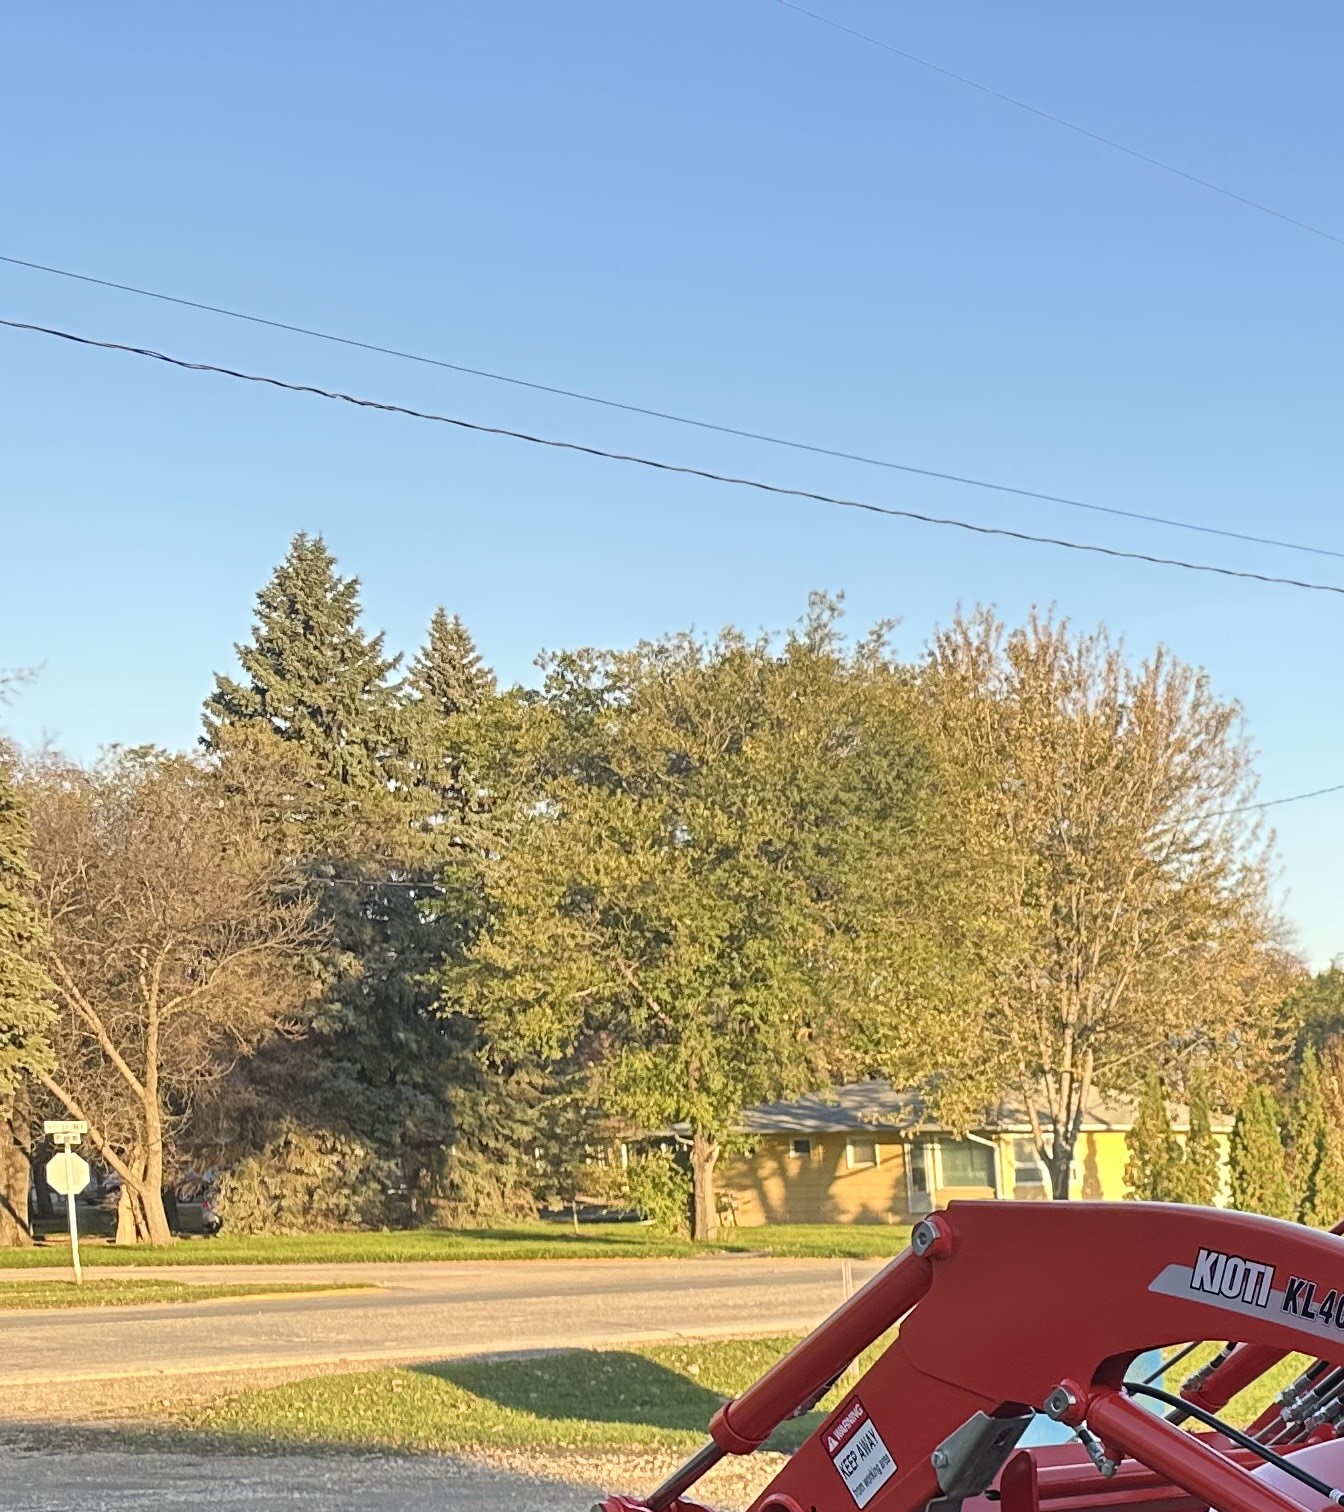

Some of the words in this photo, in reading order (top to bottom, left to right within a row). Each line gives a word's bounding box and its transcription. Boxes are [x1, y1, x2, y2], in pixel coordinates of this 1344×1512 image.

[1190, 1247, 1276, 1308] KIOTI
[833, 1404, 864, 1440] WARNING
[839, 1450, 858, 1480] KEEP
[856, 1428, 879, 1461] AWAY
